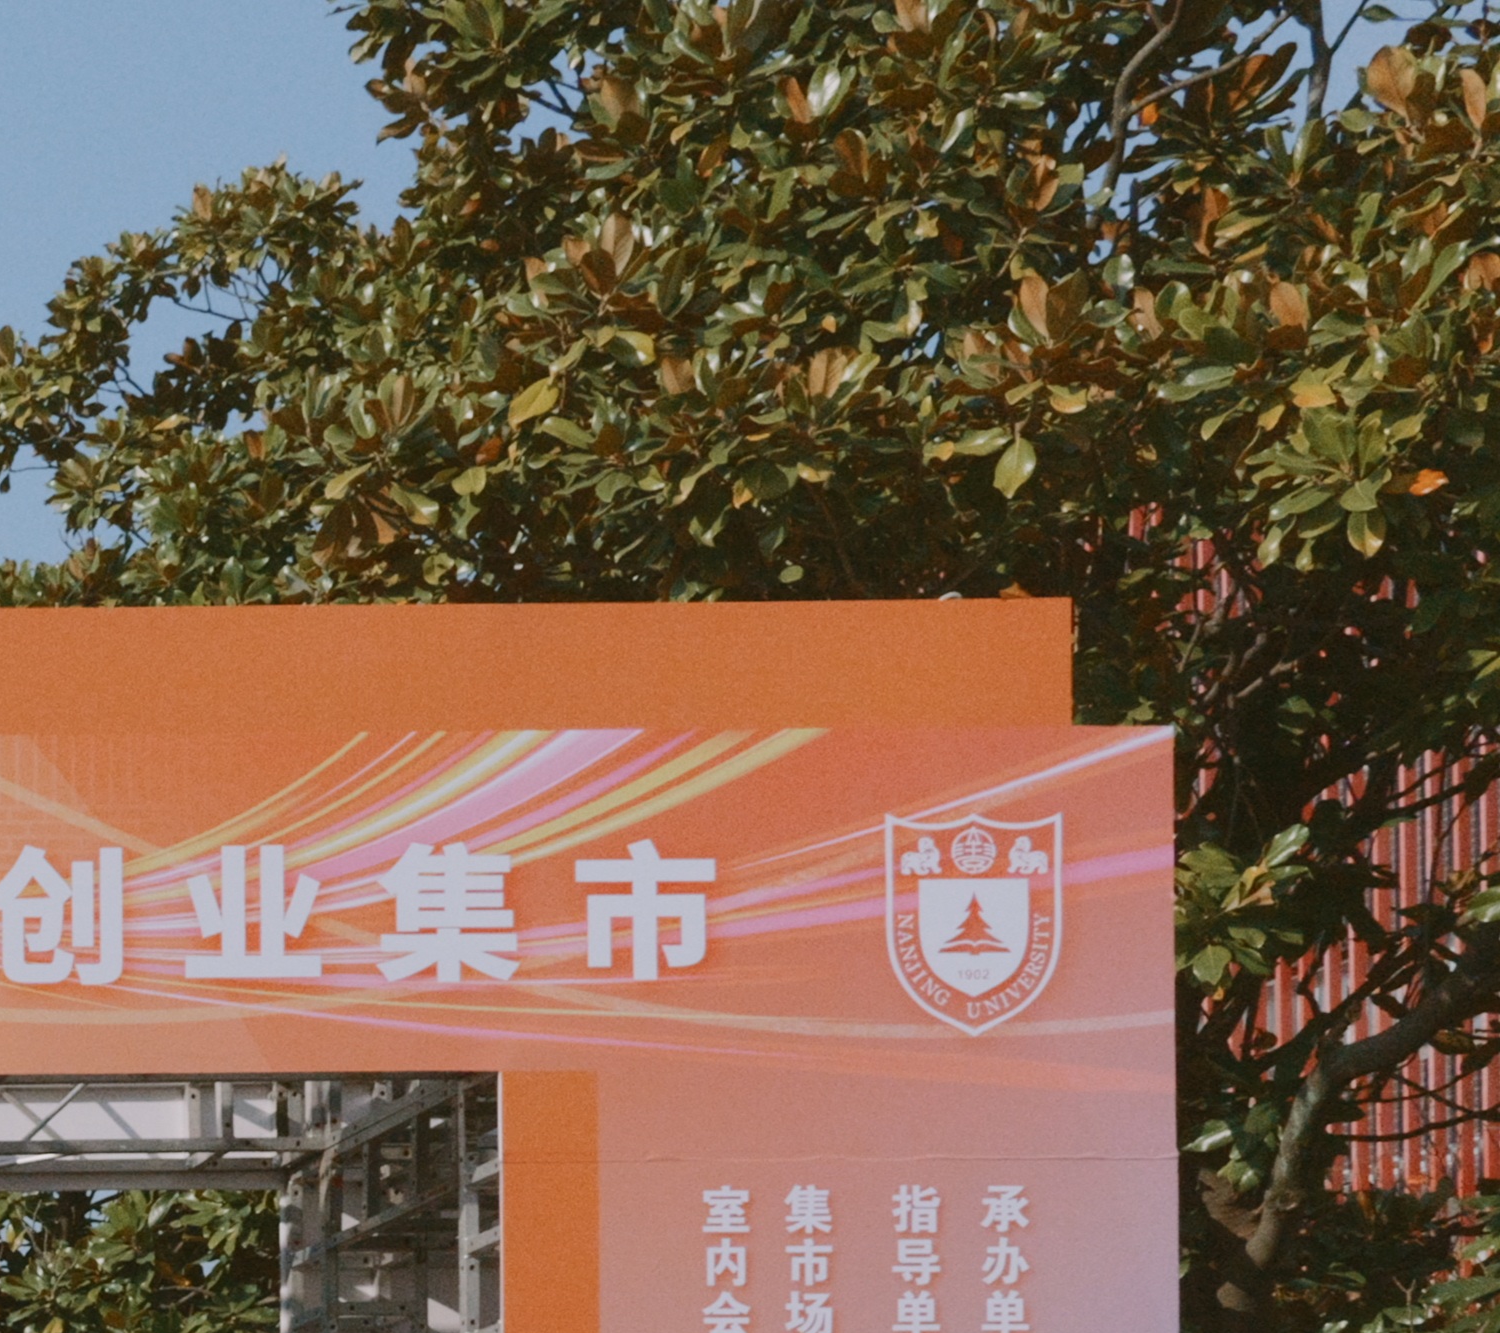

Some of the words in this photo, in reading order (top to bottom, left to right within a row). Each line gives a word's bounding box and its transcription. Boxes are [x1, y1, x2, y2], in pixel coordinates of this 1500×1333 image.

[897, 913, 951, 1007] NANJING
[958, 968, 990, 980] 1902
[966, 912, 1051, 1019] UNIVERSITY
